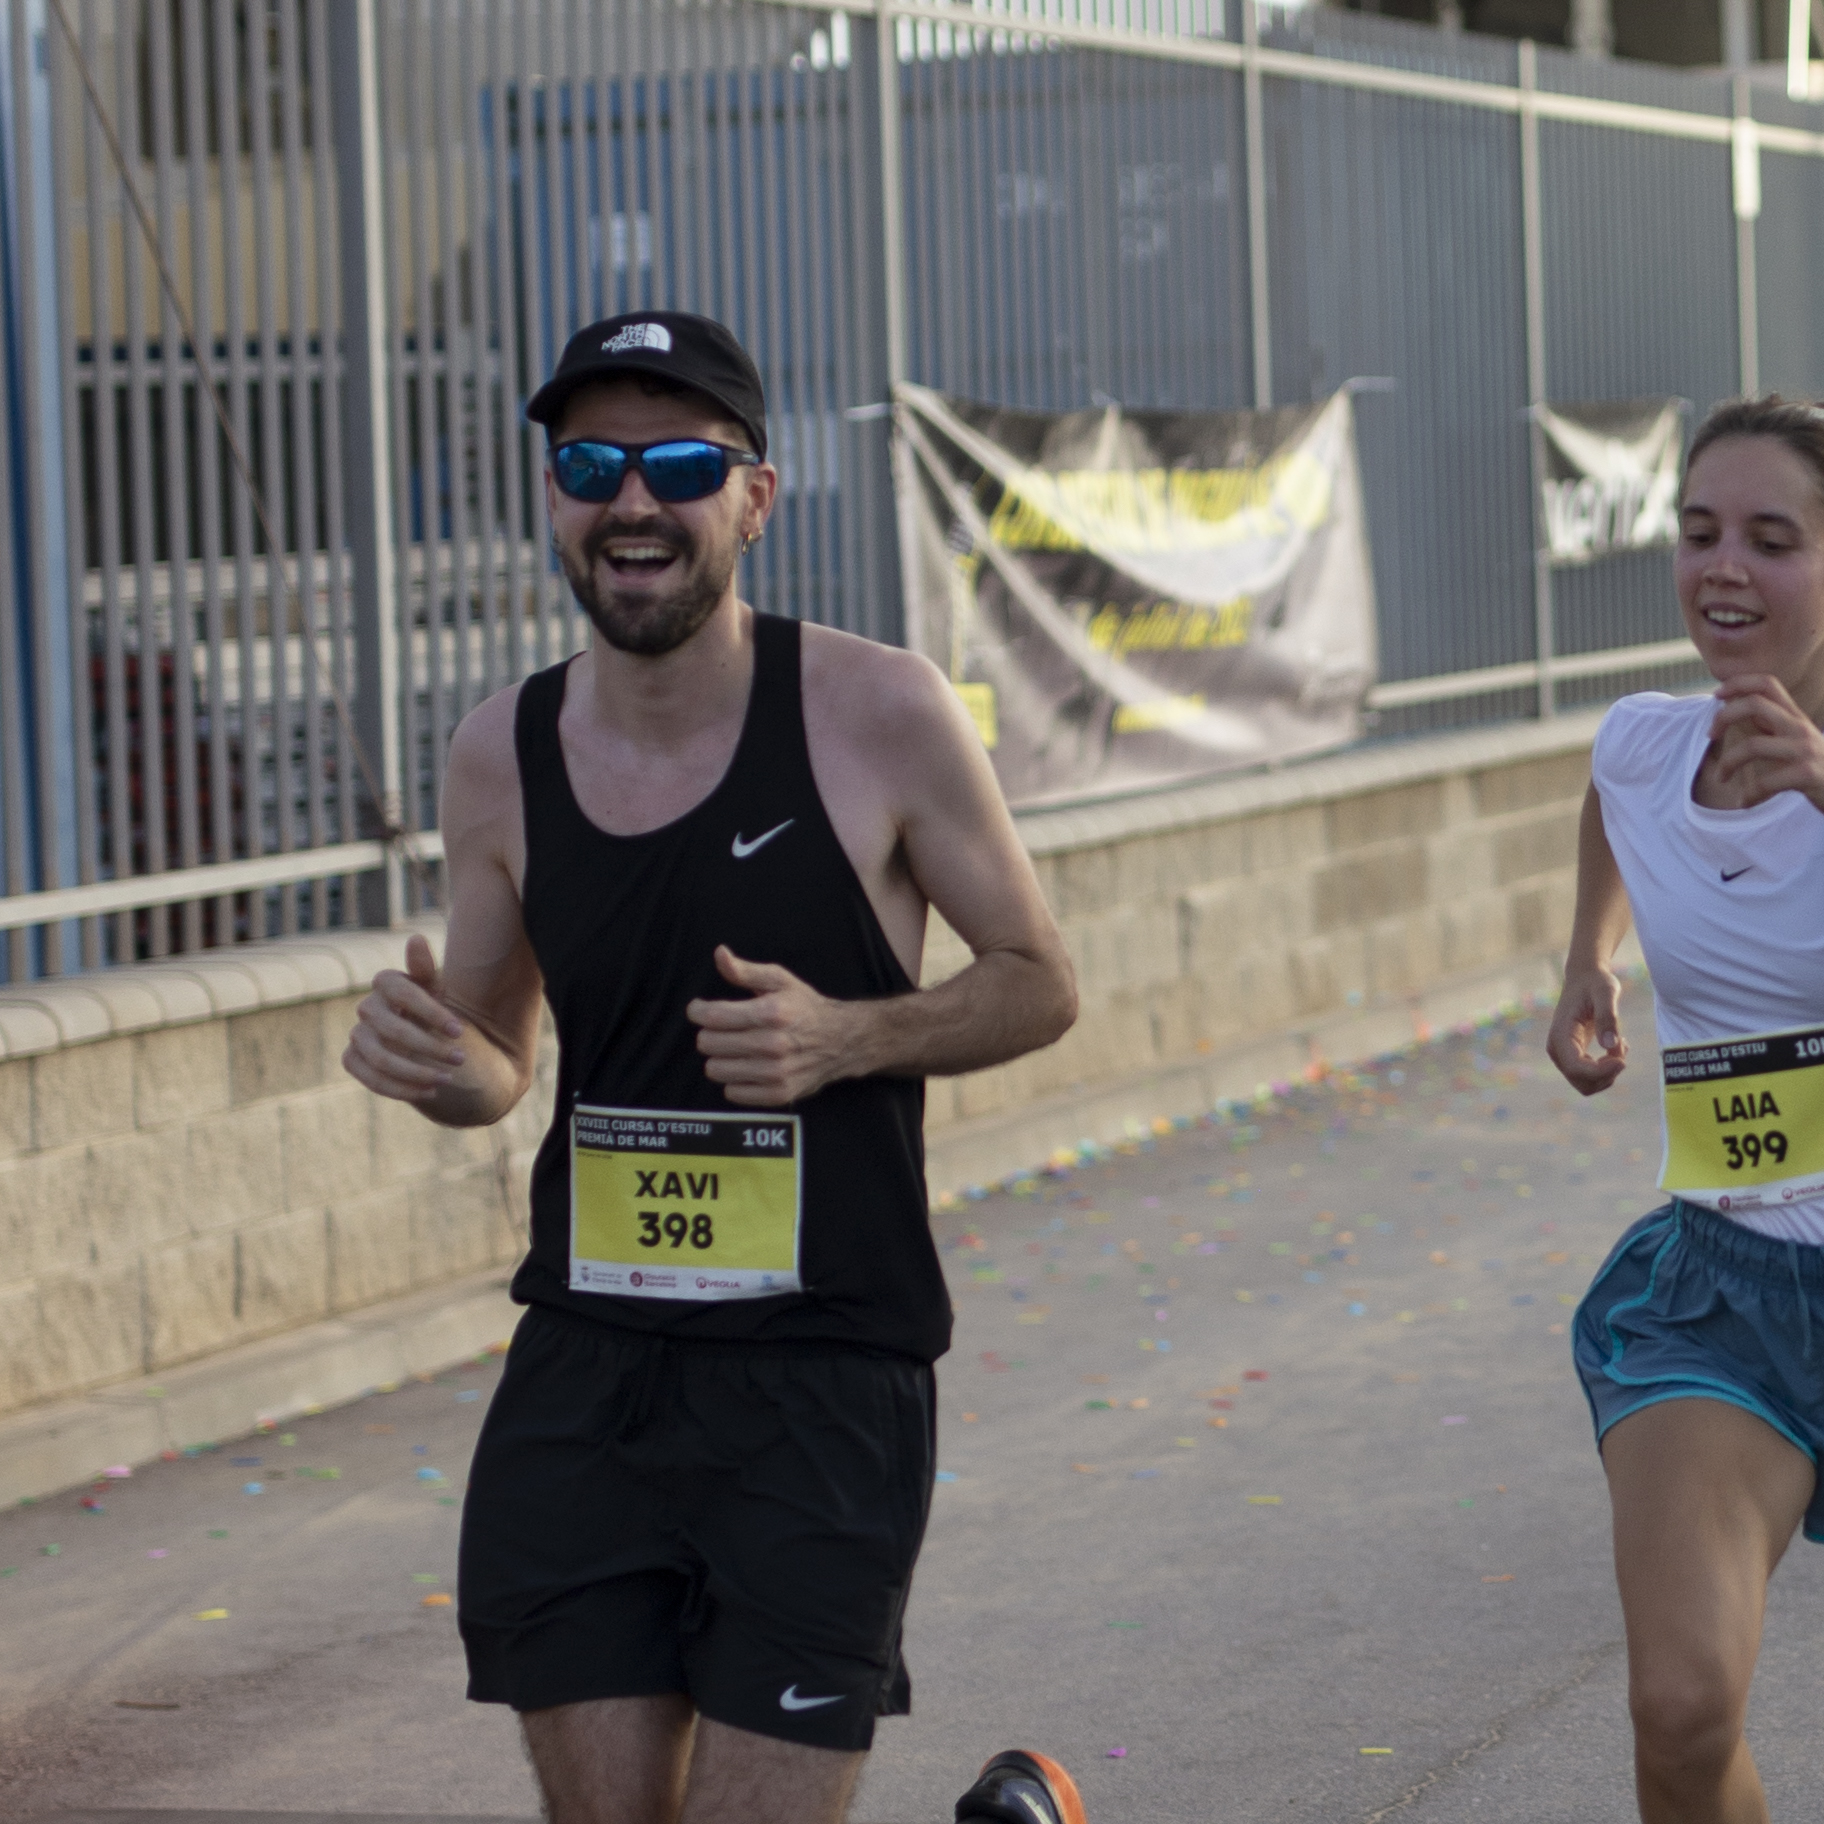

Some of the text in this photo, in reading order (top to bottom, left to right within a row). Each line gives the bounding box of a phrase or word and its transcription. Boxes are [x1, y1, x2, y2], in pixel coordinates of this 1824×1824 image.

[620, 323, 646, 334] THE
[611, 339, 643, 353] FACE
[1688, 1048, 1719, 1062] CURSA
[1693, 1064, 1707, 1076] DE
[1707, 1061, 1731, 1074] MAR
[1712, 1090, 1781, 1124] LAIA
[611, 1119, 655, 1132] CURSA
[657, 1121, 711, 1135] D'ESTIU
[617, 1134, 635, 1146] DE
[638, 1136, 668, 1148] MAR
[742, 1128, 787, 1147] 10K
[1721, 1130, 1788, 1170] 399
[634, 1170, 719, 1200] XAVI
[636, 1211, 714, 1250] 398
